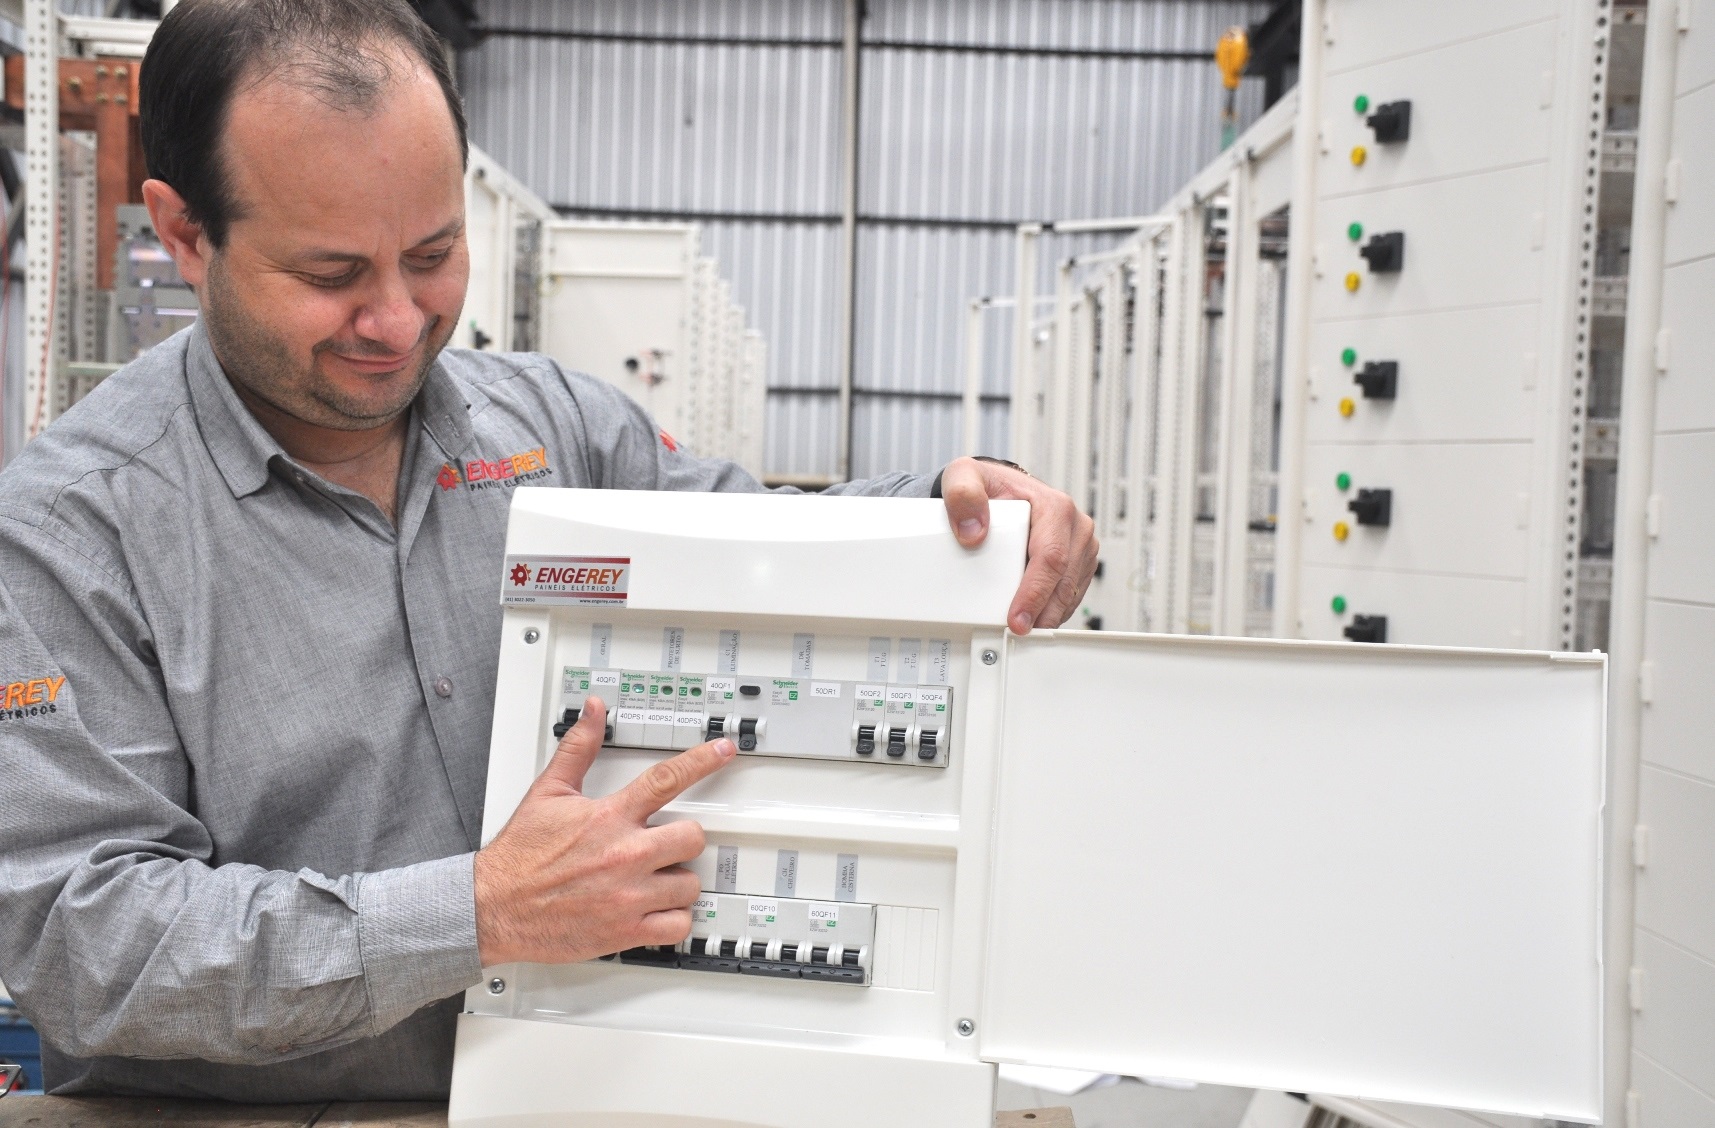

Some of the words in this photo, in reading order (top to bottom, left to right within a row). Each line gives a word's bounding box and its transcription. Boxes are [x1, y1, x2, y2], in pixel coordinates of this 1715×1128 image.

[466, 447, 547, 482] ENGEREY
[535, 567, 624, 585] ENGEREY
[571, 584, 616, 592] ELÉTRICOS
[730, 633, 738, 672] ILUMINAÇÃO
[804, 640, 812, 670] TOMADAS
[565, 670, 590, 678] Schneider
[622, 673, 645, 681] Schneider
[596, 676, 616, 684] 40QF0
[650, 675, 674, 683] Schneider
[680, 676, 703, 685] Schneider
[772, 680, 798, 688] Schneider
[815, 687, 836, 695] 50DR1
[648, 714, 673, 722] 40DPS2
[677, 717, 702, 725] 40DPS3
[730, 853, 738, 884] ELÉTRICO
[787, 856, 795, 889] CHUVEIRO
[847, 862, 855, 893] CISTERNA
[750, 904, 776, 912] 60QF10
